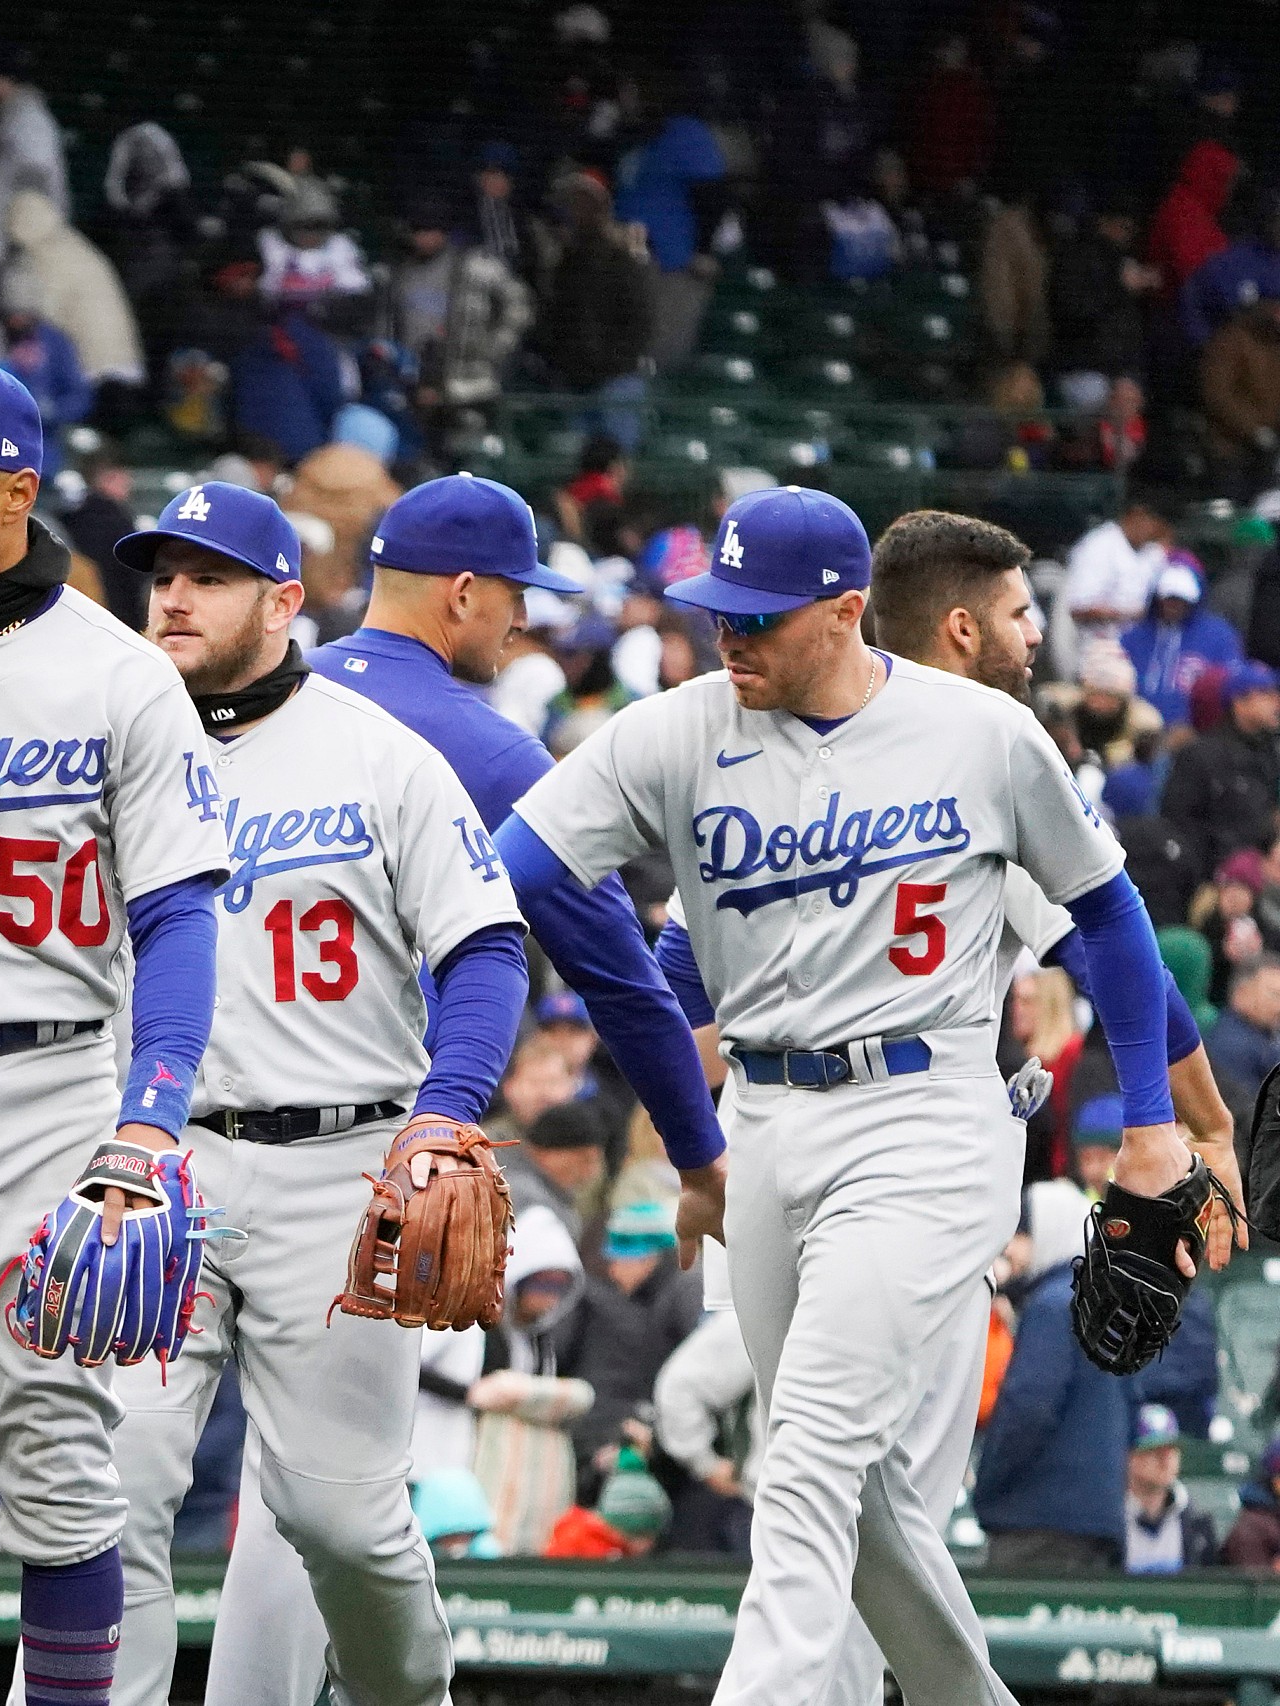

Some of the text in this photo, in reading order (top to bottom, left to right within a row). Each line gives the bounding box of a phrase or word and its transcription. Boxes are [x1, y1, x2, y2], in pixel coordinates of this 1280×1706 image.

[178, 486, 211, 521] LA
[720, 520, 744, 569] LA
[183, 752, 224, 822] LA
[452, 816, 505, 882] LA
[693, 791, 971, 909] Dodgers
[263, 900, 359, 1002] 13
[888, 882, 947, 975] 5
[91, 1154, 147, 1175] Wilson
[45, 1276, 65, 1319] A2K
